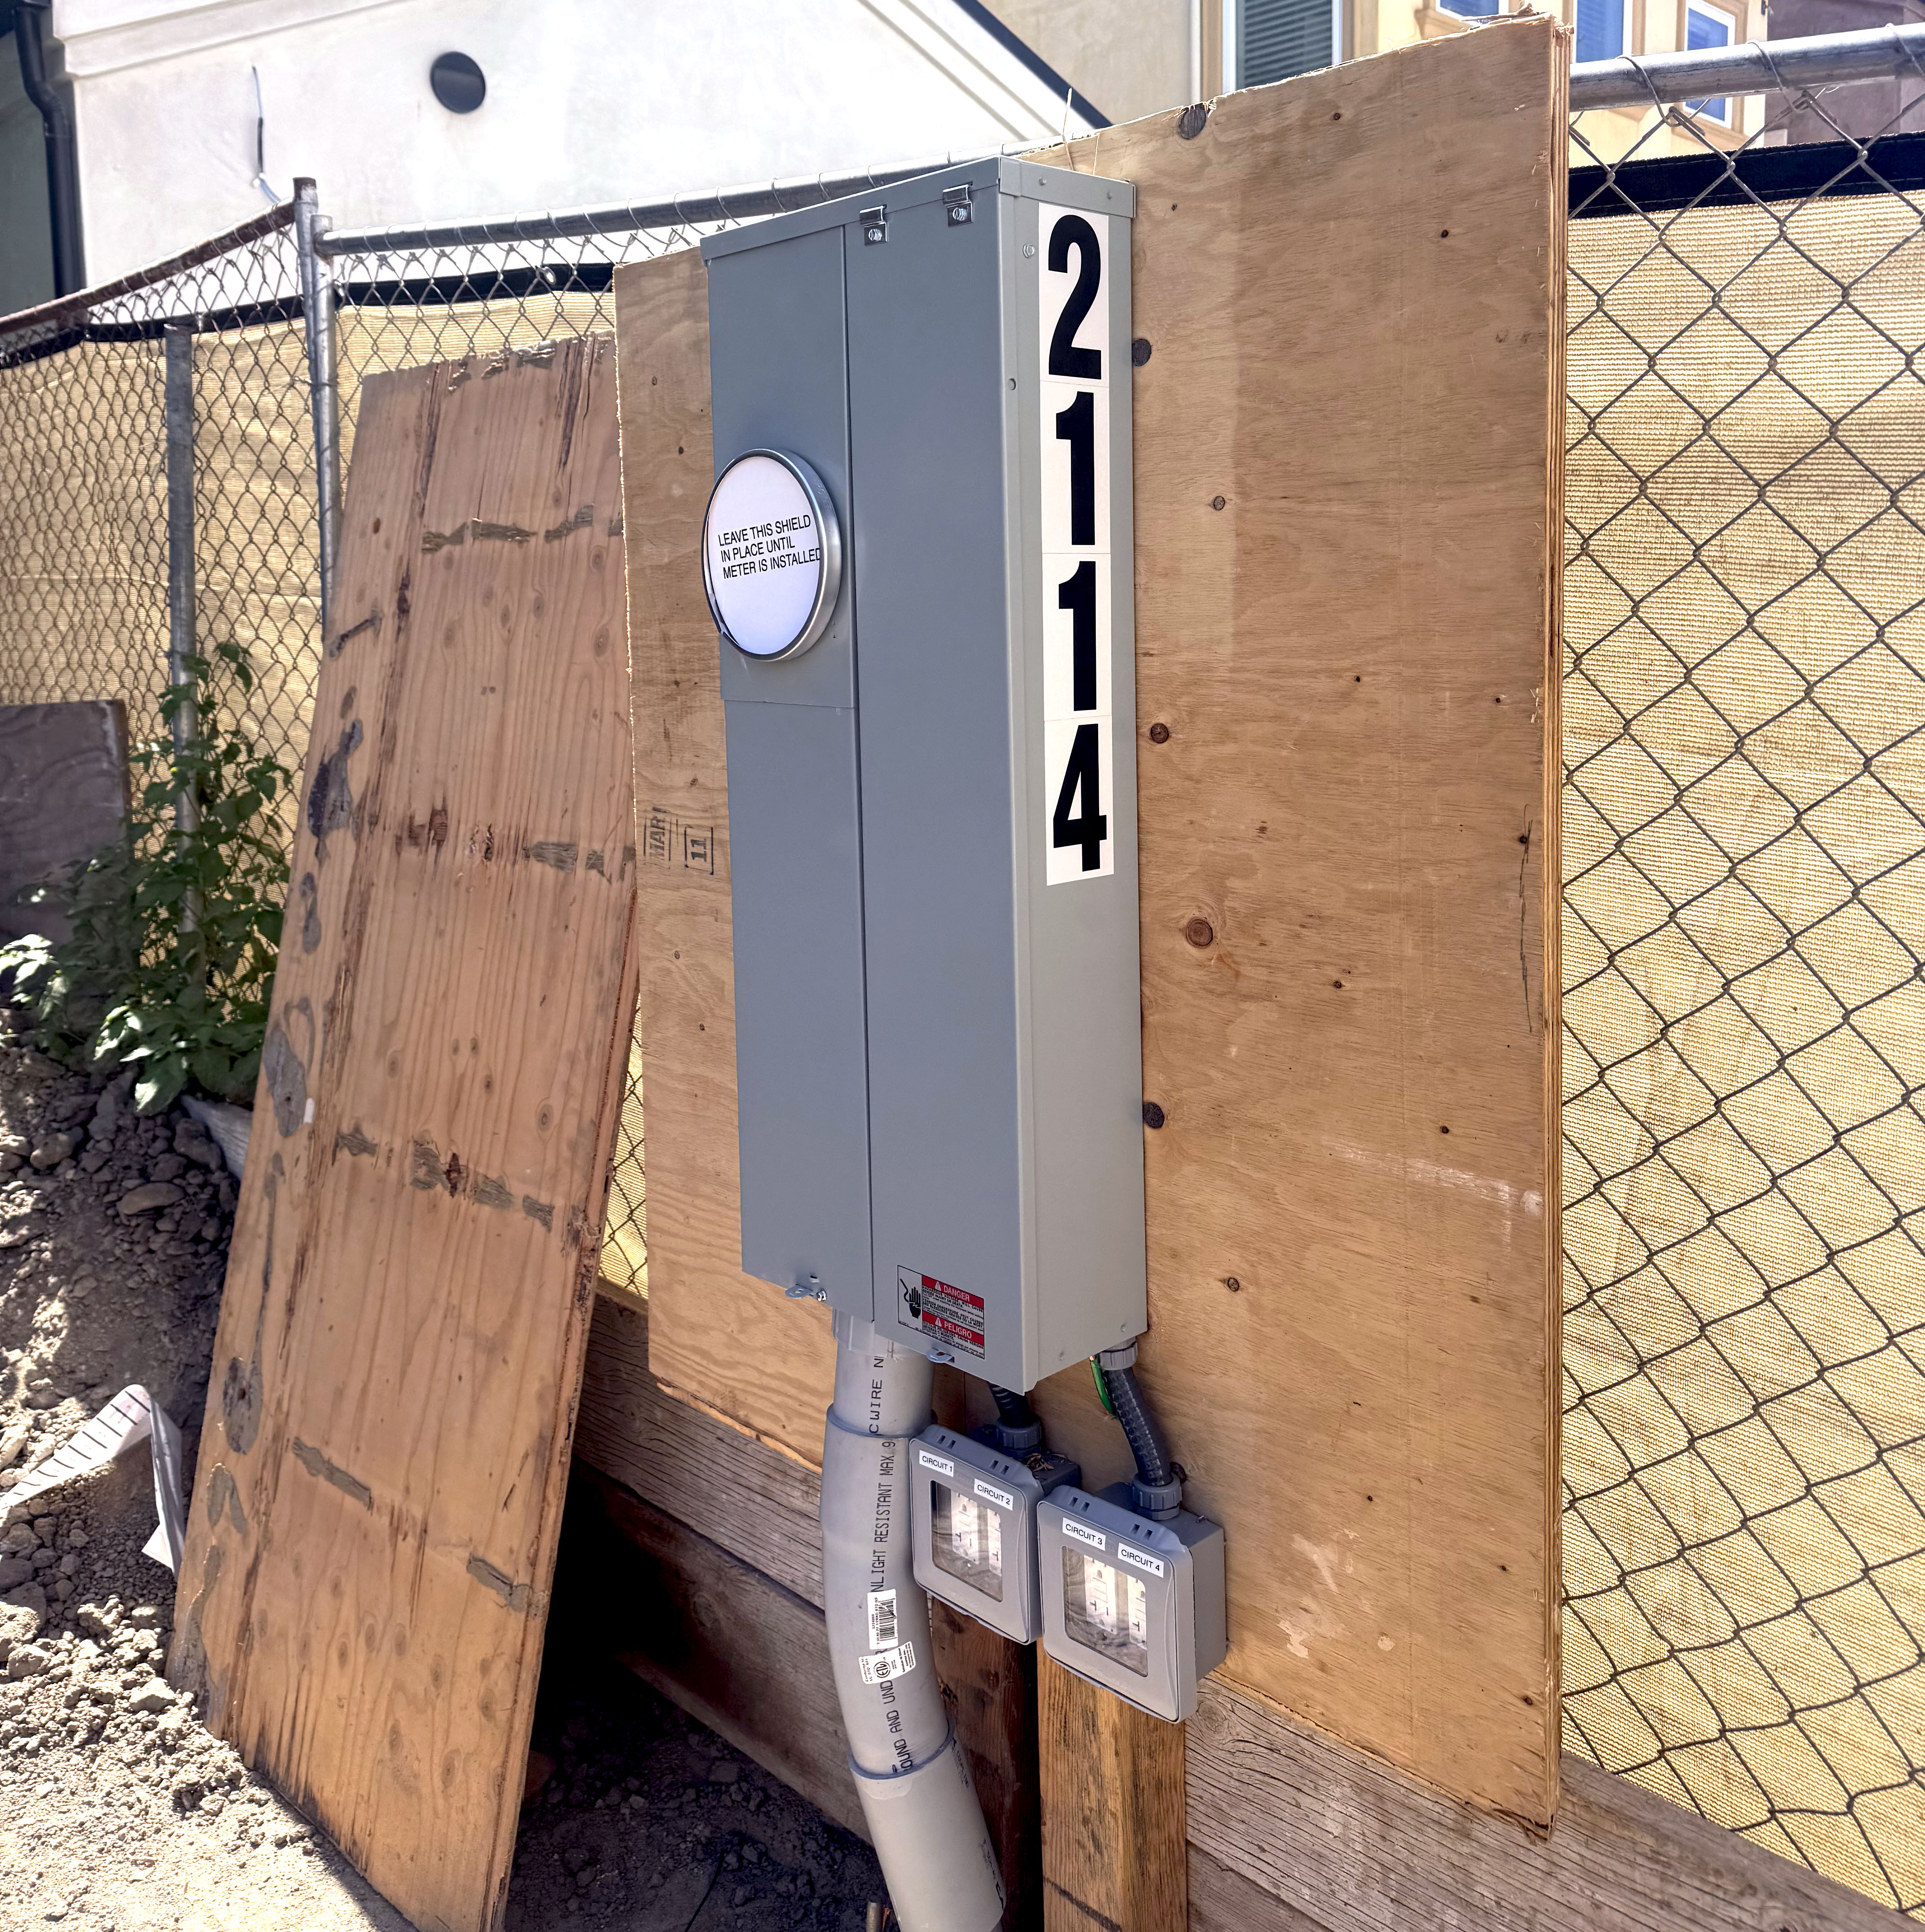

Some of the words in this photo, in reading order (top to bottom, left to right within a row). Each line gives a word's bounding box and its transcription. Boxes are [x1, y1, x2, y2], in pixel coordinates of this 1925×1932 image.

[718, 529, 749, 546] LEAVE
[750, 523, 773, 539] THIS
[775, 515, 811, 534] SHIELD
[721, 549, 731, 562] IN
[733, 542, 764, 560] PLACE
[766, 536, 795, 553] UNTIL
[1048, 215, 1107, 871] 2114
[723, 561, 756, 579] METER
[758, 559, 768, 572] IS
[691, 838, 707, 862] 11
[944, 1285, 970, 1302] DANGER
[944, 1321, 972, 1338] PELIGRO
[874, 1356, 884, 1368] N
[870, 1379, 882, 1420] WIRE
[869, 1424, 878, 1433] C
[882, 1439, 896, 1448] 9
[879, 1455, 894, 1475] MAX
[922, 1456, 948, 1472] CIRCUIT
[977, 1484, 1005, 1503] CIRCUIT
[874, 1483, 892, 1542] RESISTANT
[1065, 1524, 1096, 1542] CIRCUIT
[1121, 1549, 1153, 1567] CIRCUIT
[870, 1550, 887, 1592] NLIGHT
[886, 1710, 903, 1733] AND
[894, 1739, 912, 1769] OUND
